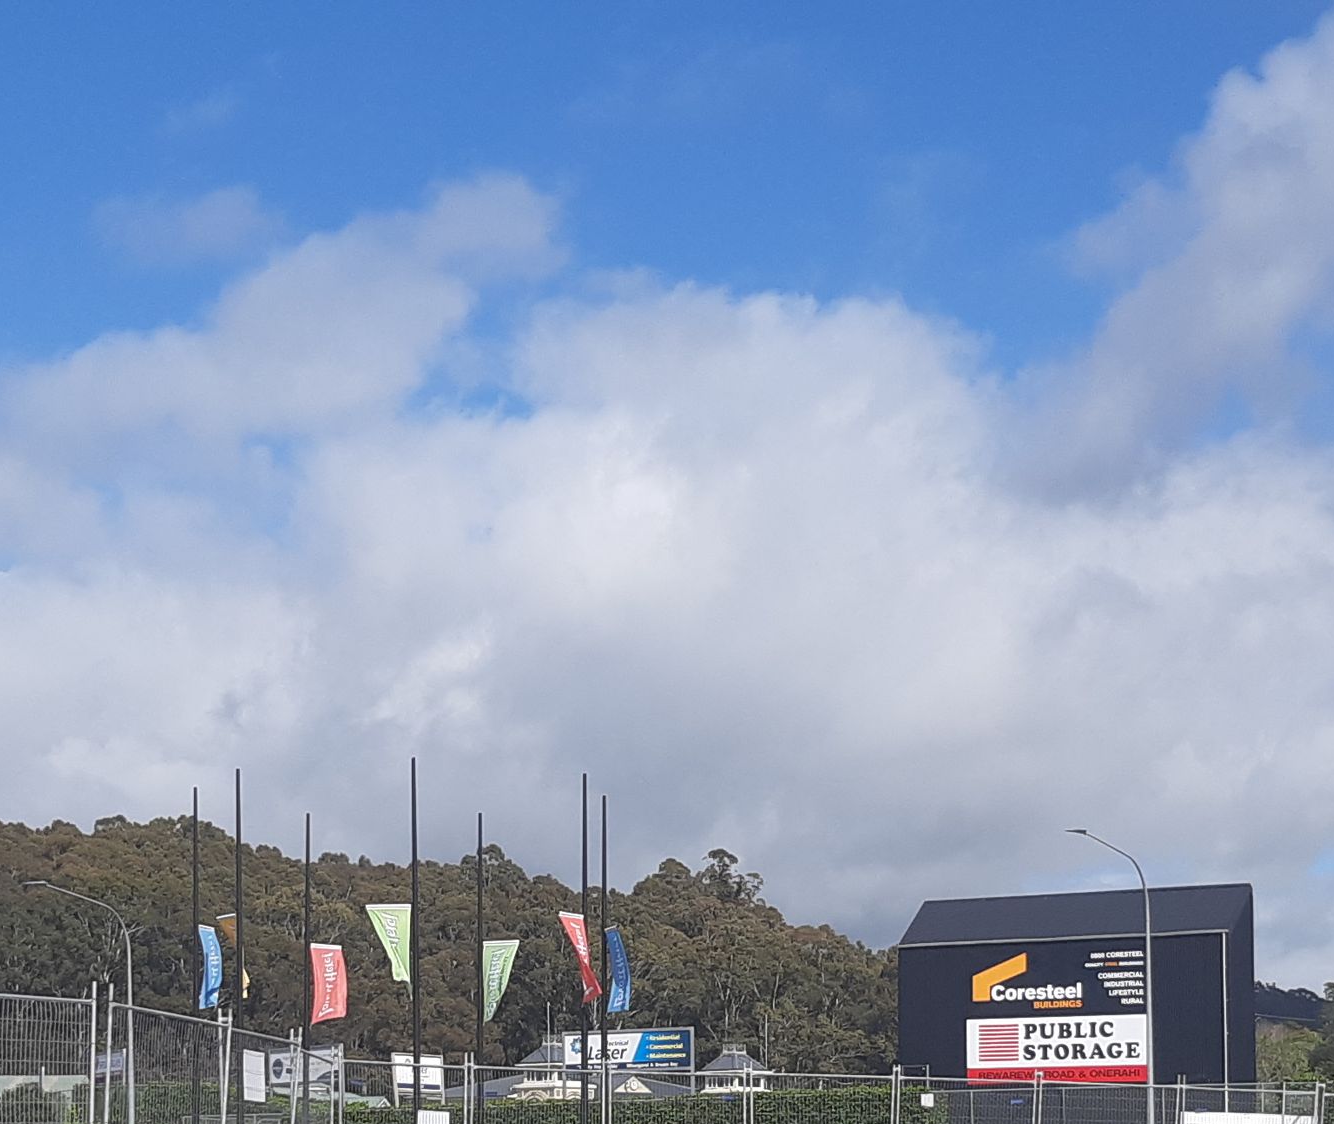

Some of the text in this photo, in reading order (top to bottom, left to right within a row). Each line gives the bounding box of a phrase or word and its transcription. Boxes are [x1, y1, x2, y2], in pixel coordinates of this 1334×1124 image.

[1097, 971, 1144, 979] COMMERCIAL
[1103, 980, 1144, 988] INDUSTRIAL
[991, 982, 1082, 1001] Coresteel
[1033, 1000, 1083, 1009] BUILDINGS
[1023, 1021, 1114, 1040] PUBLIC
[1023, 1042, 1140, 1061] STORAGE
[978, 1067, 1140, 1080] REWAREW ROAD & ONERAHI
